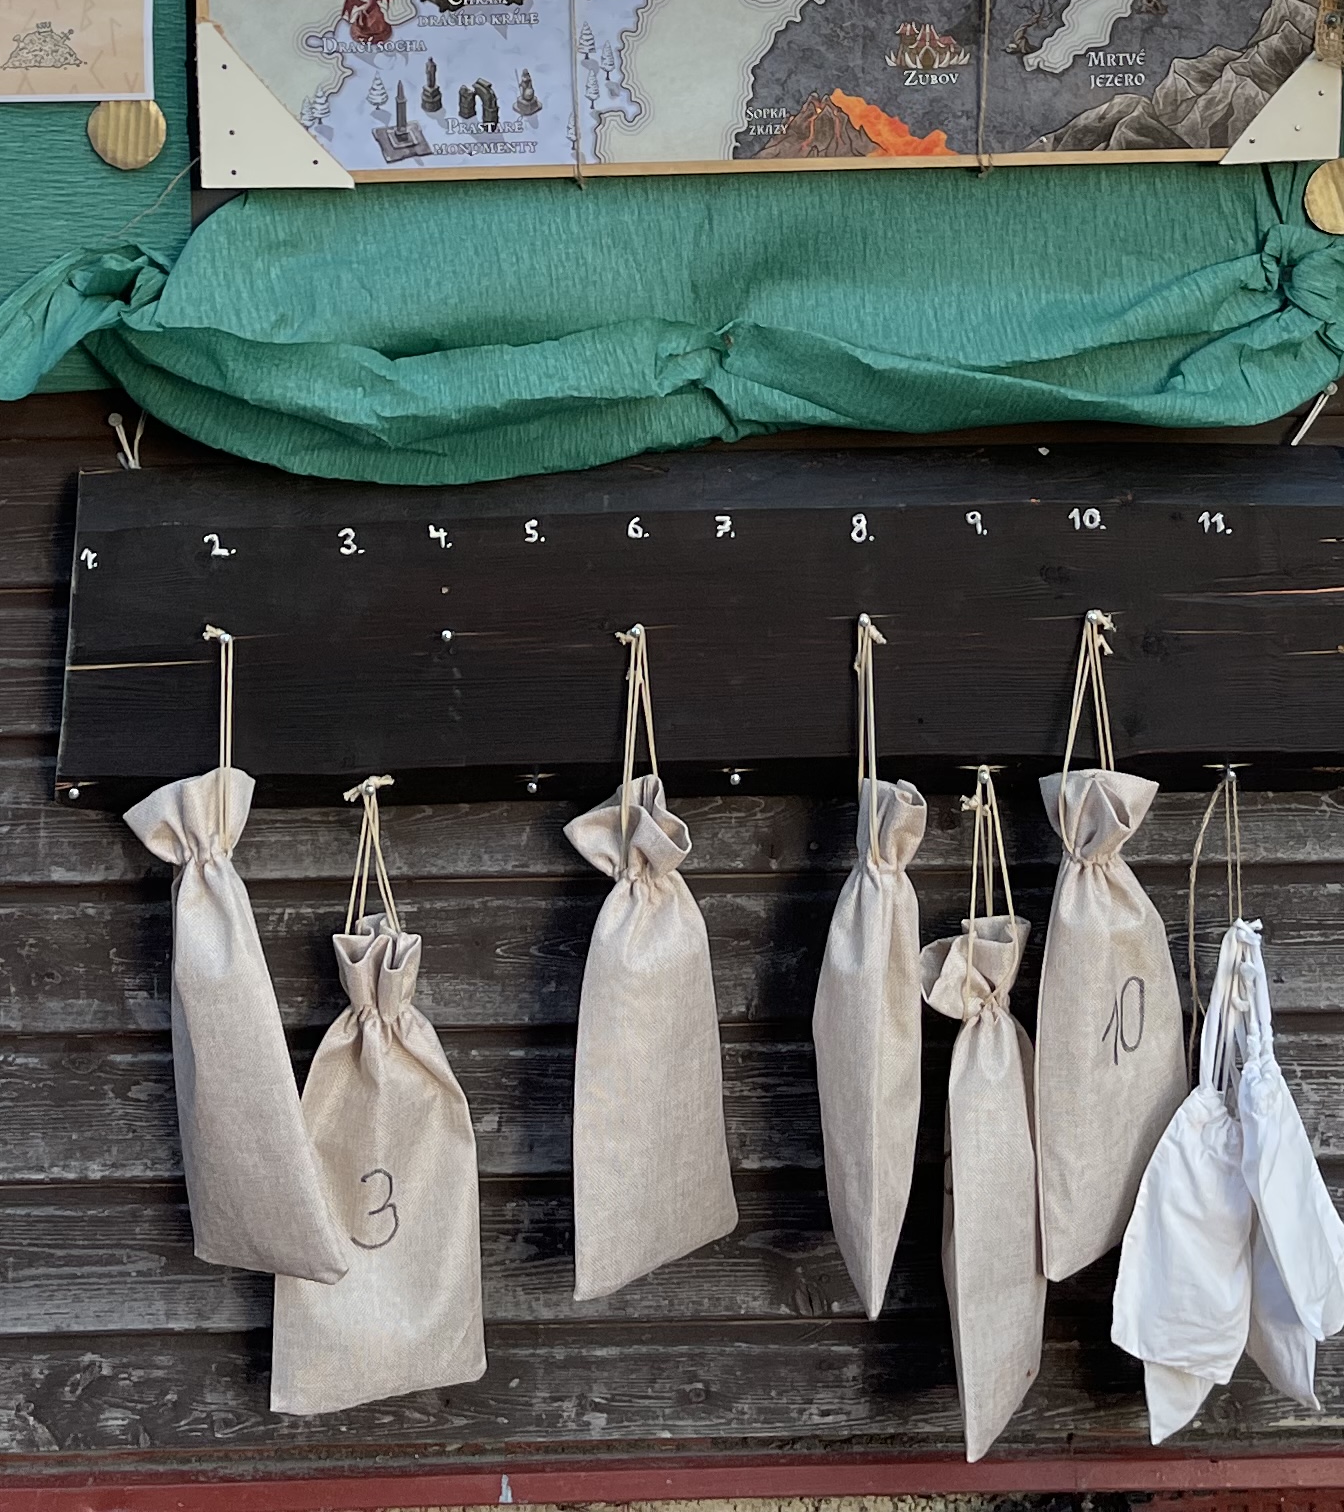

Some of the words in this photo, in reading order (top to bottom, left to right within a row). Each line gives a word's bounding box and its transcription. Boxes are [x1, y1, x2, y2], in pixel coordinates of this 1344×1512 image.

[524, 519, 547, 544] 5.
[627, 516, 651, 540] 6.
[714, 514, 737, 539] 7.
[849, 513, 875, 544] 8.
[965, 510, 989, 537] 9.
[1067, 506, 1108, 531] 10.
[1197, 510, 1234, 536] 11.
[203, 533, 238, 558] 2.
[338, 527, 367, 557] 3.
[427, 524, 454, 550] 4.
[1101, 975, 1146, 1066] 10
[350, 1168, 399, 1251] 3
